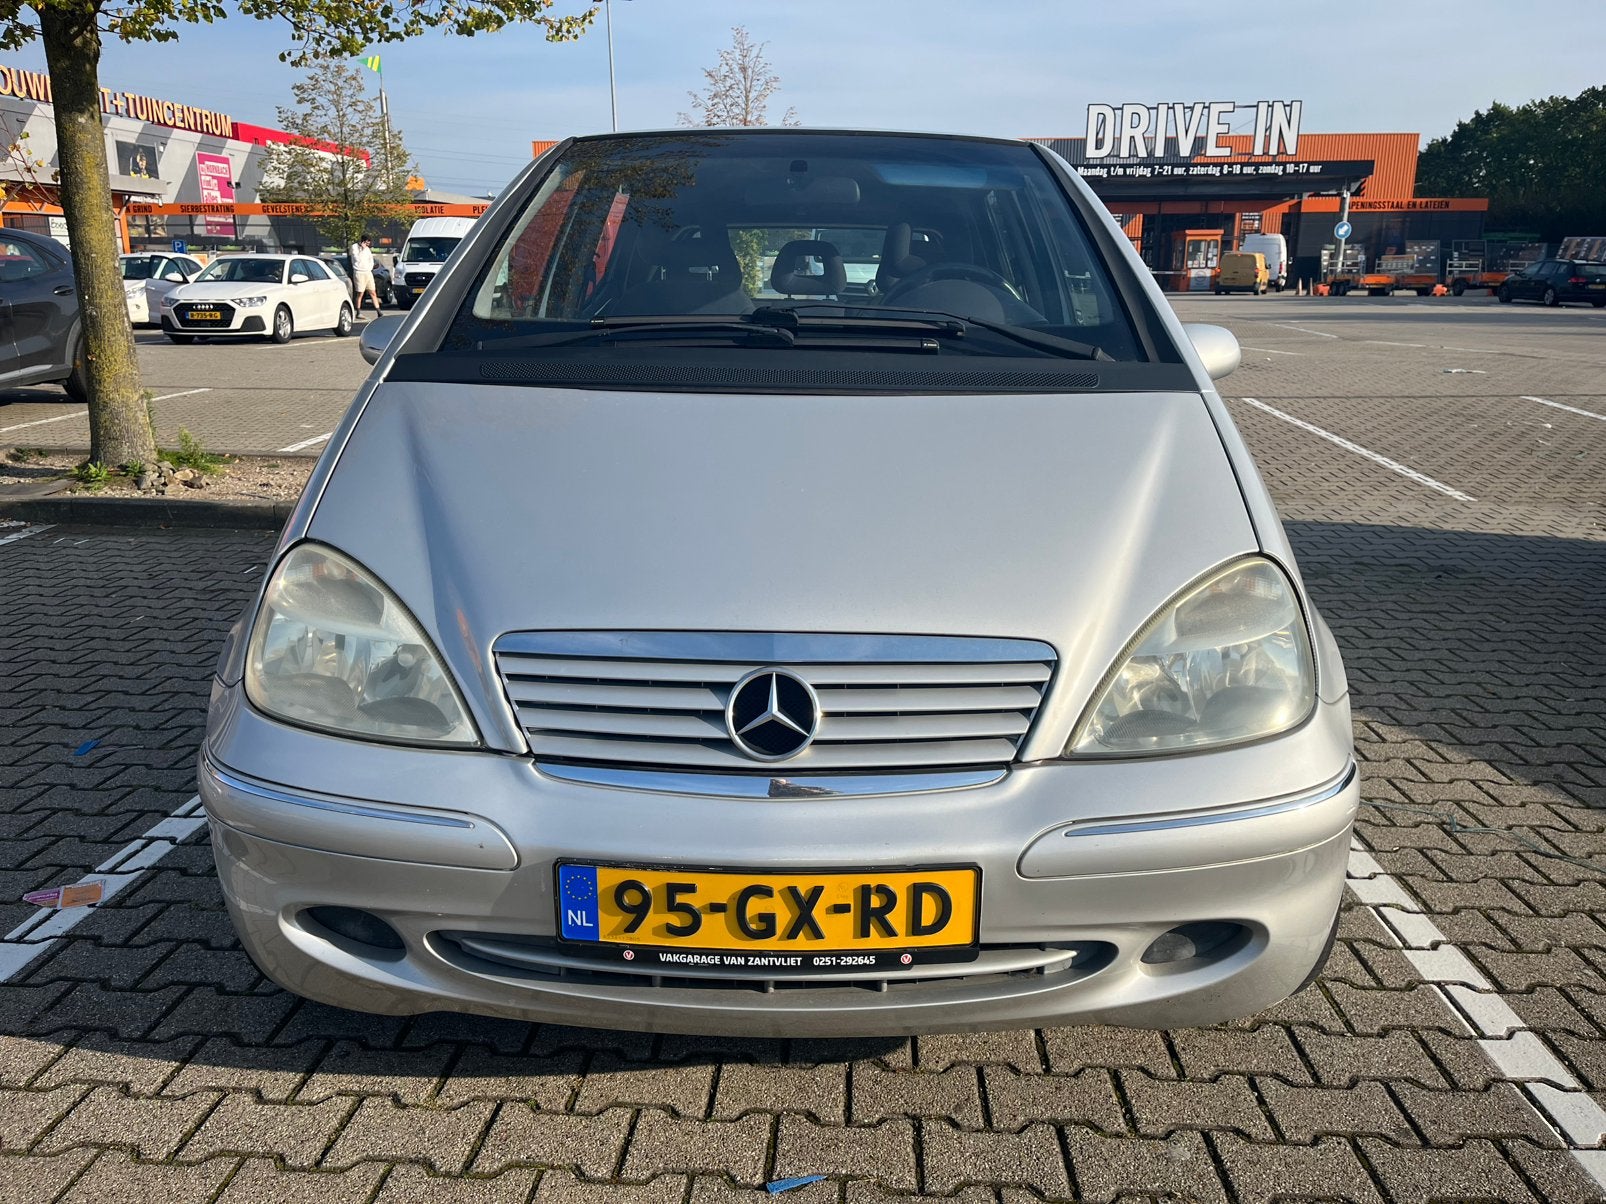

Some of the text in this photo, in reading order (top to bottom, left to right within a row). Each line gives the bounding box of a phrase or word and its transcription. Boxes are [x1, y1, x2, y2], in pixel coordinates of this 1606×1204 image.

[1085, 100, 1302, 158] DRIVE IN
[1078, 163, 1322, 178] Maandag t/m vrijdag 7-21 uur, zaterdag 8-18 uur, zondag 10-17 uur
[180, 205, 234, 213] SIERBESTRATING
[1407, 201, 1416, 209] EN
[567, 879, 952, 939] NL 95-GX-RD
[659, 953, 720, 965] VAKGARAGE
[723, 955, 745, 966] VAN
[747, 956, 802, 966] ZANTVLIET
[813, 955, 876, 966] 0251-292645
